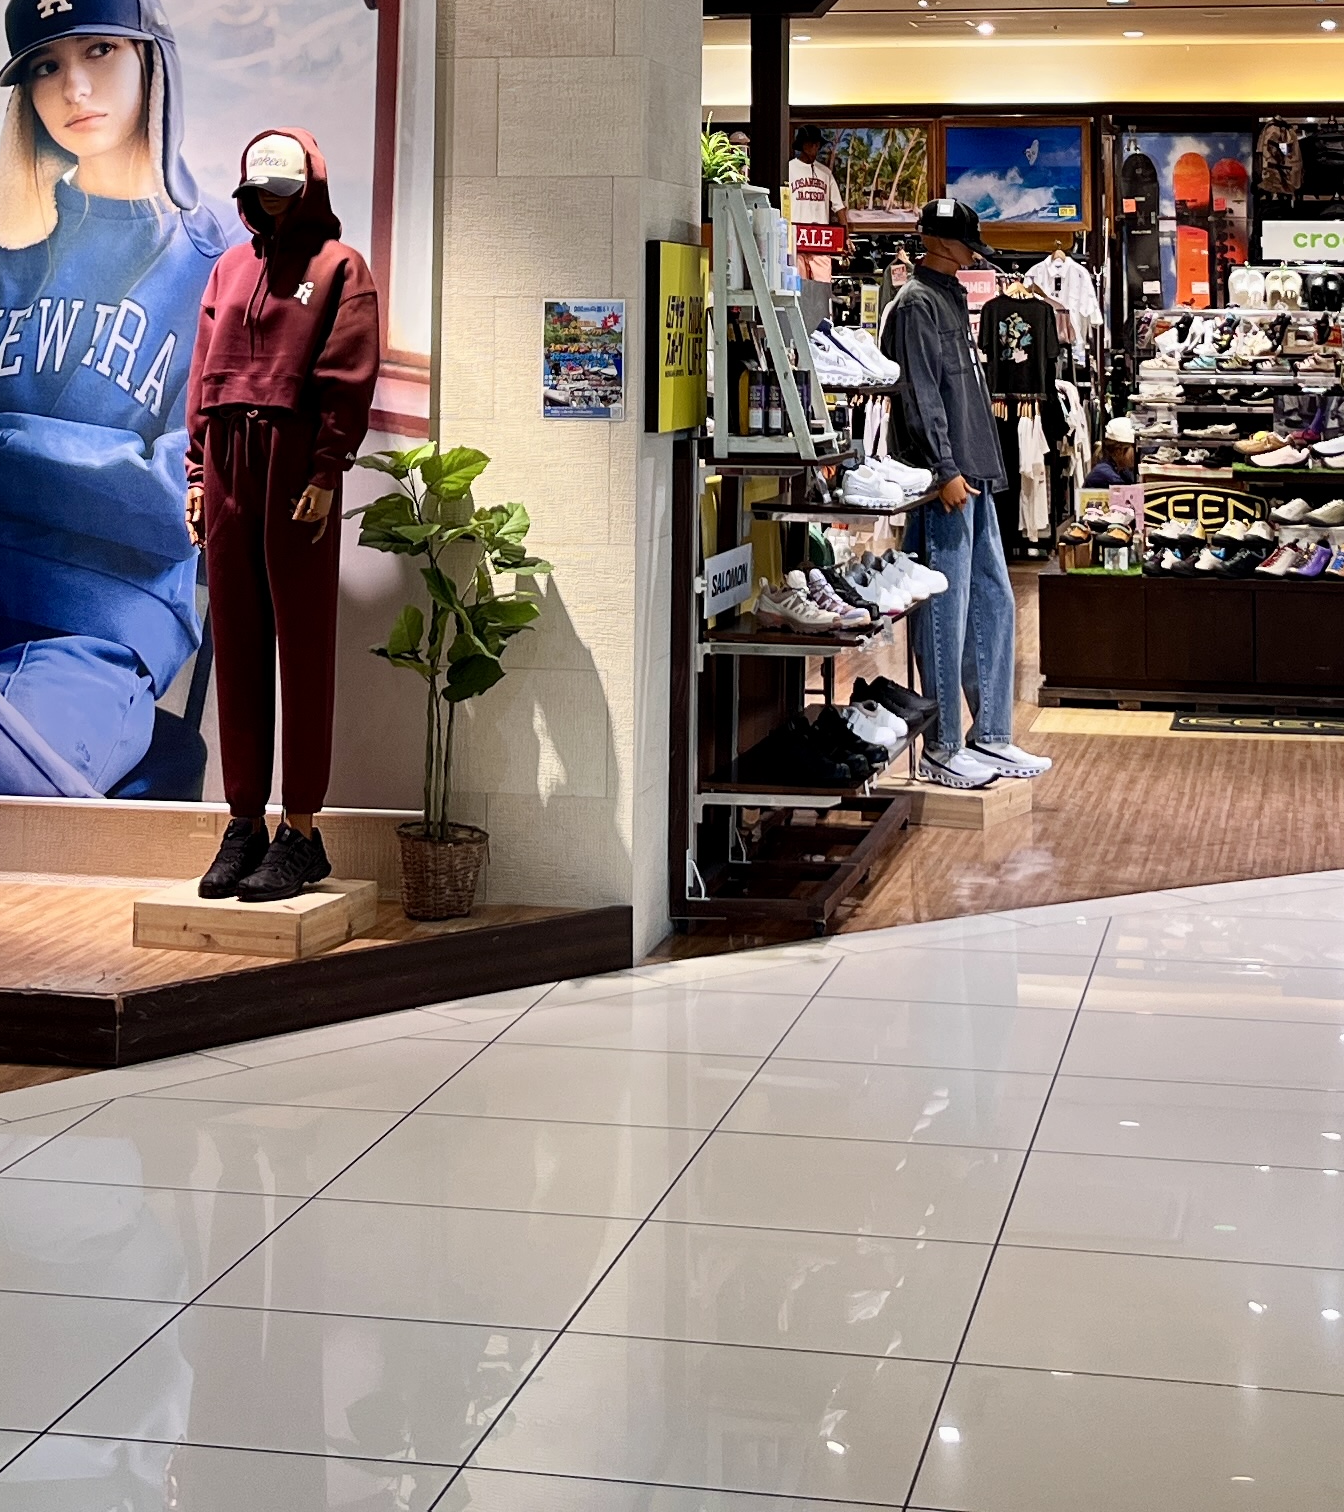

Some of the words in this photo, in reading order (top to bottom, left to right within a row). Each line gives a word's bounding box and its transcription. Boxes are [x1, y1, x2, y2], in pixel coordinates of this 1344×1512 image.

[796, 228, 833, 247] ALE
[962, 281, 991, 294] OMEN
[712, 563, 748, 597] SALOMON
